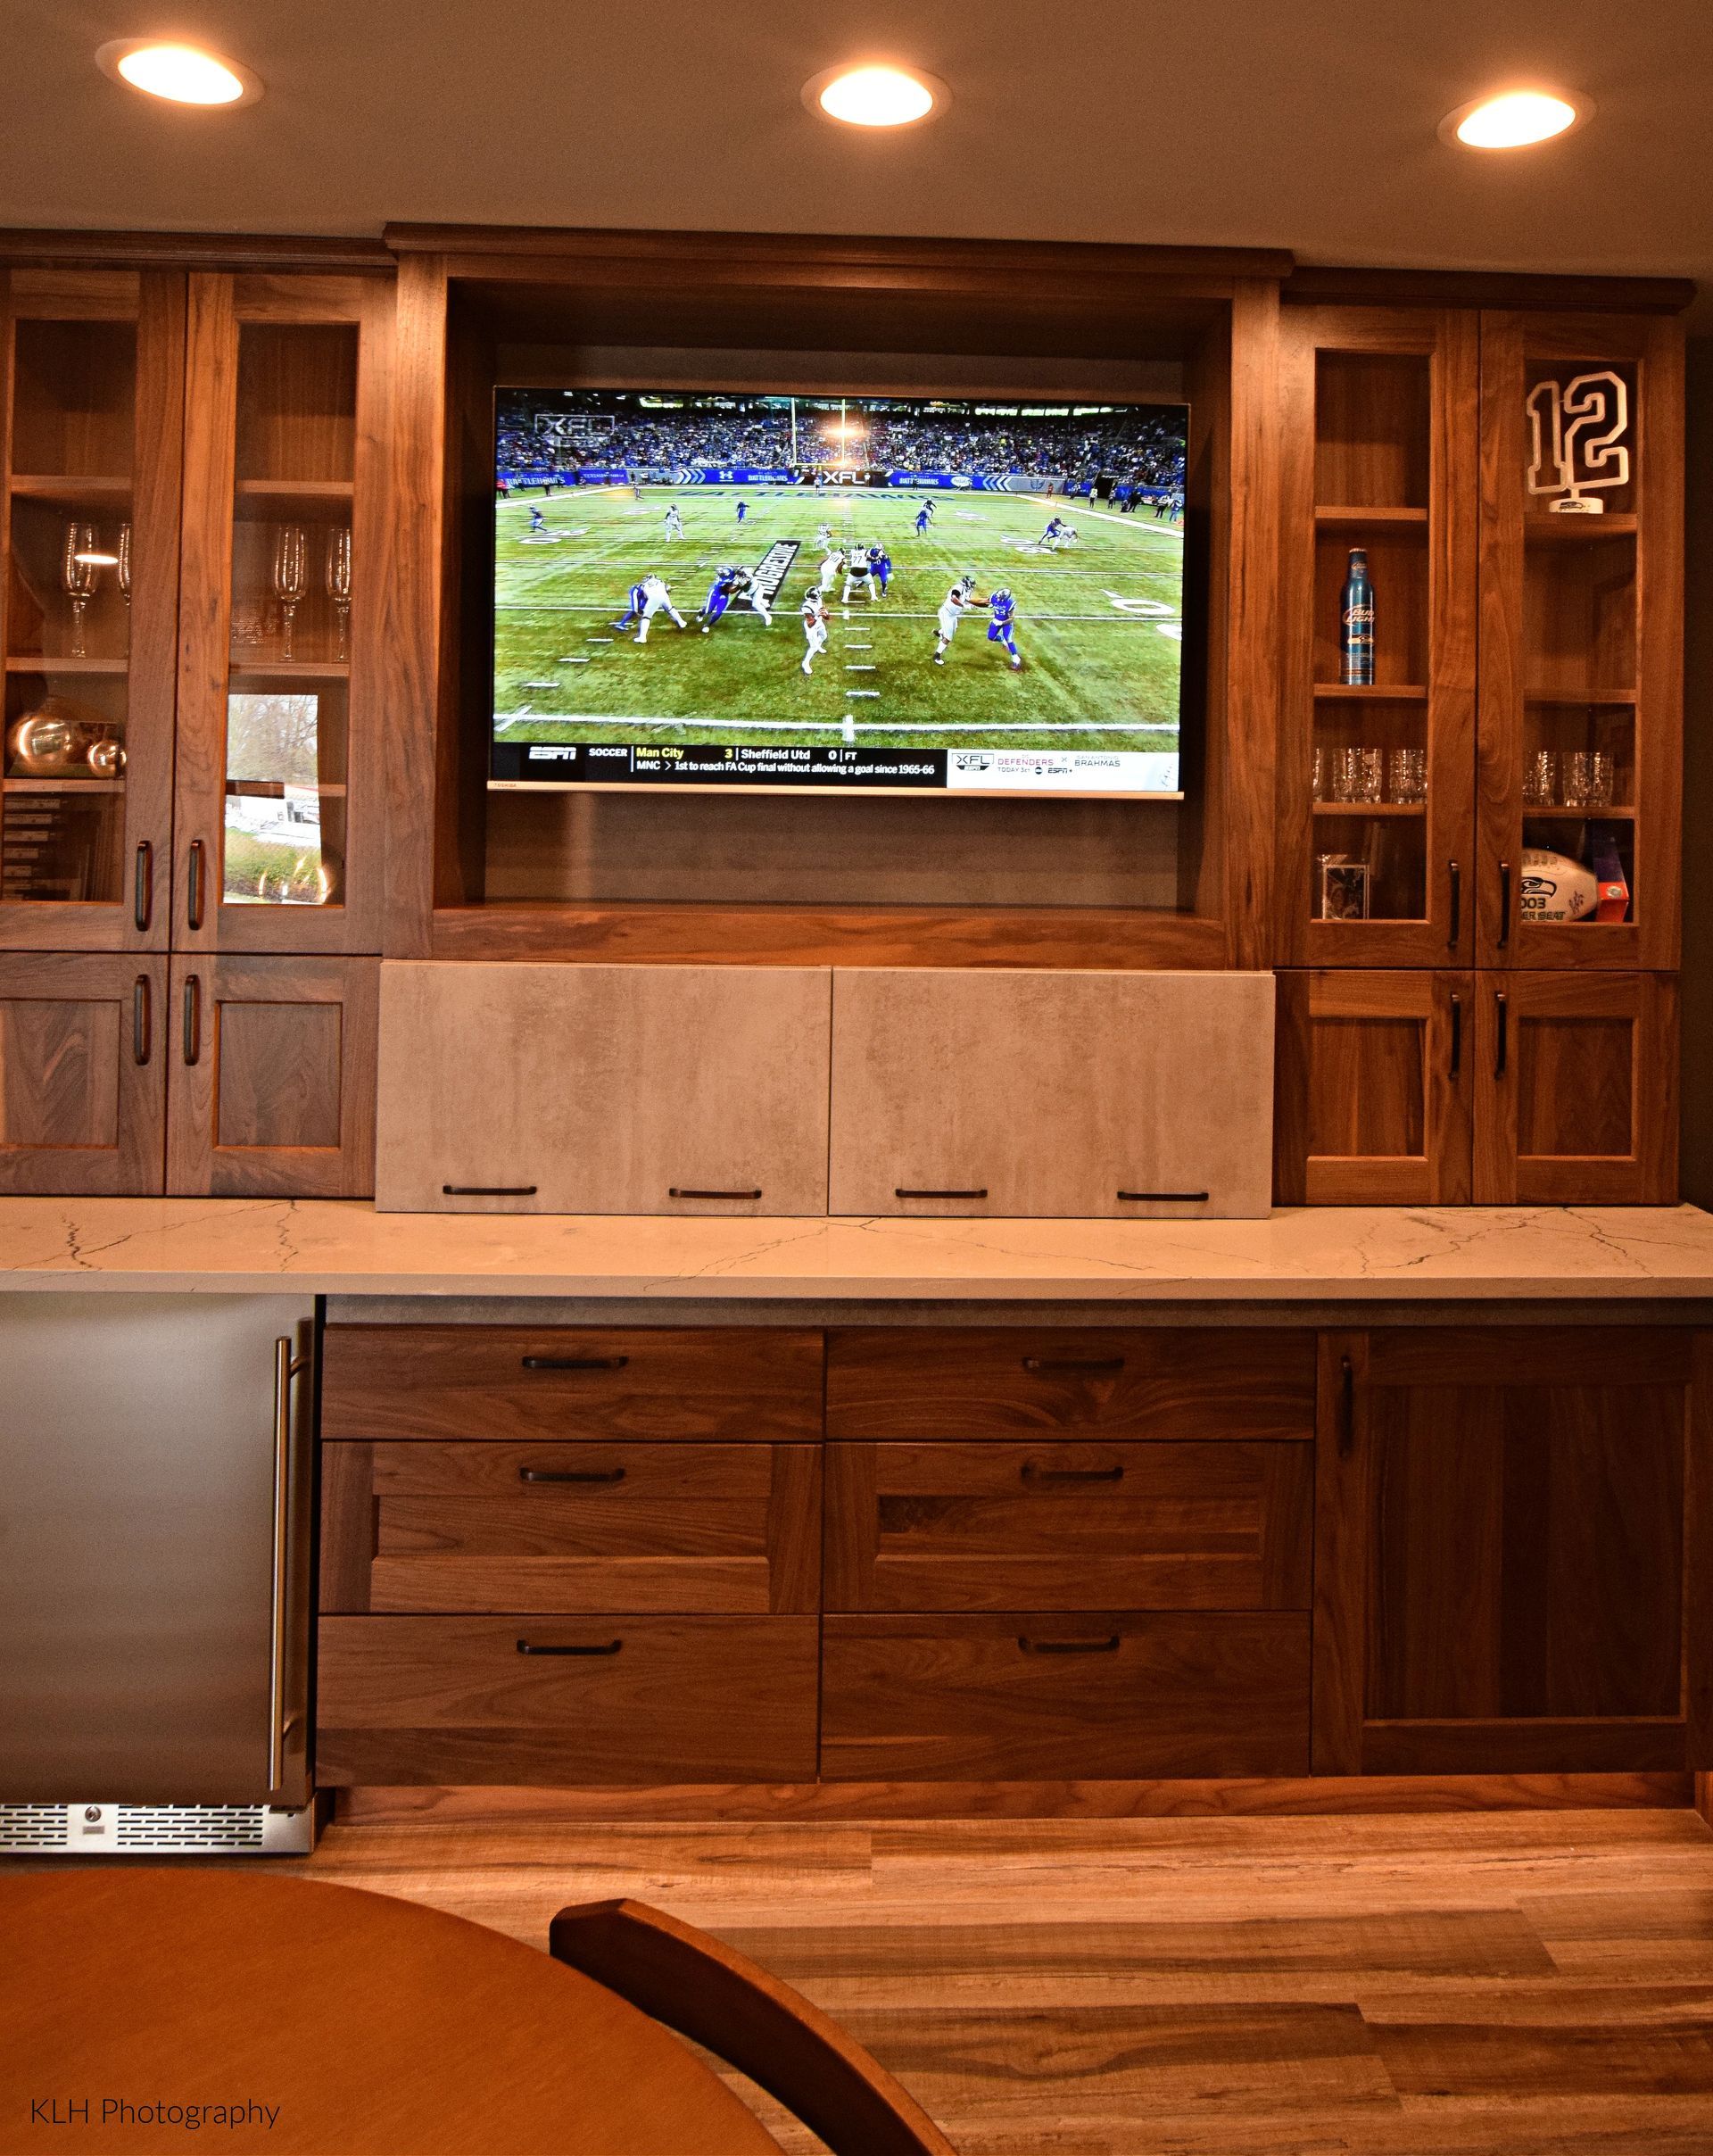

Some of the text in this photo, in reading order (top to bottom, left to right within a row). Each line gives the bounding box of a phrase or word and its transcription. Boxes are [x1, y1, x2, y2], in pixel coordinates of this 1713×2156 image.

[1527, 371, 1629, 495] 12
[823, 470, 865, 485] XFL
[1352, 609, 1375, 617] BUD
[528, 746, 577, 760] ESPN
[588, 748, 628, 757] SOCCER
[636, 748, 732, 759] Man City 3
[741, 750, 837, 760] Sheffield Utd 0
[845, 751, 857, 760] FT
[956, 755, 990, 764] XFL
[997, 759, 1055, 767] DEFENDERS
[1074, 759, 1121, 767] BRAHMAS
[636, 760, 935, 775] MNC 1st to reach FA Cup final without allowing a goal since 1965-66
[1521, 898, 1546, 909] 003
